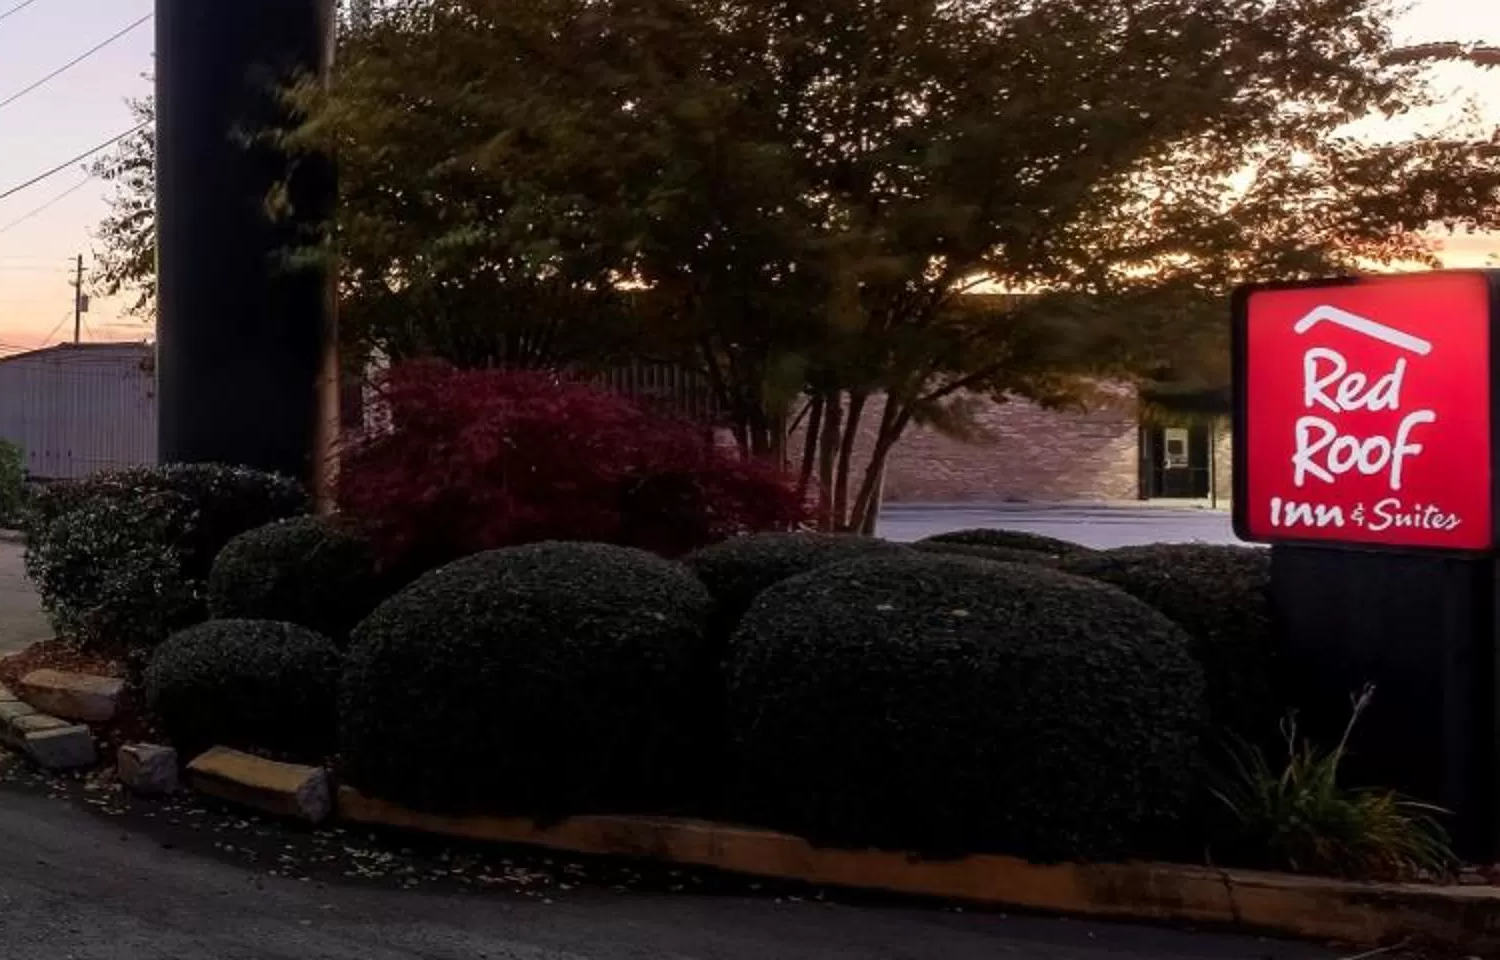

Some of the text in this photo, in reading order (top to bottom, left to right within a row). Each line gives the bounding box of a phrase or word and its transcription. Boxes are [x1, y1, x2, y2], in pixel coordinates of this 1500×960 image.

[1303, 347, 1407, 413] Red
[1291, 409, 1436, 490] Roof
[1269, 496, 1461, 531] Inn & Suites
